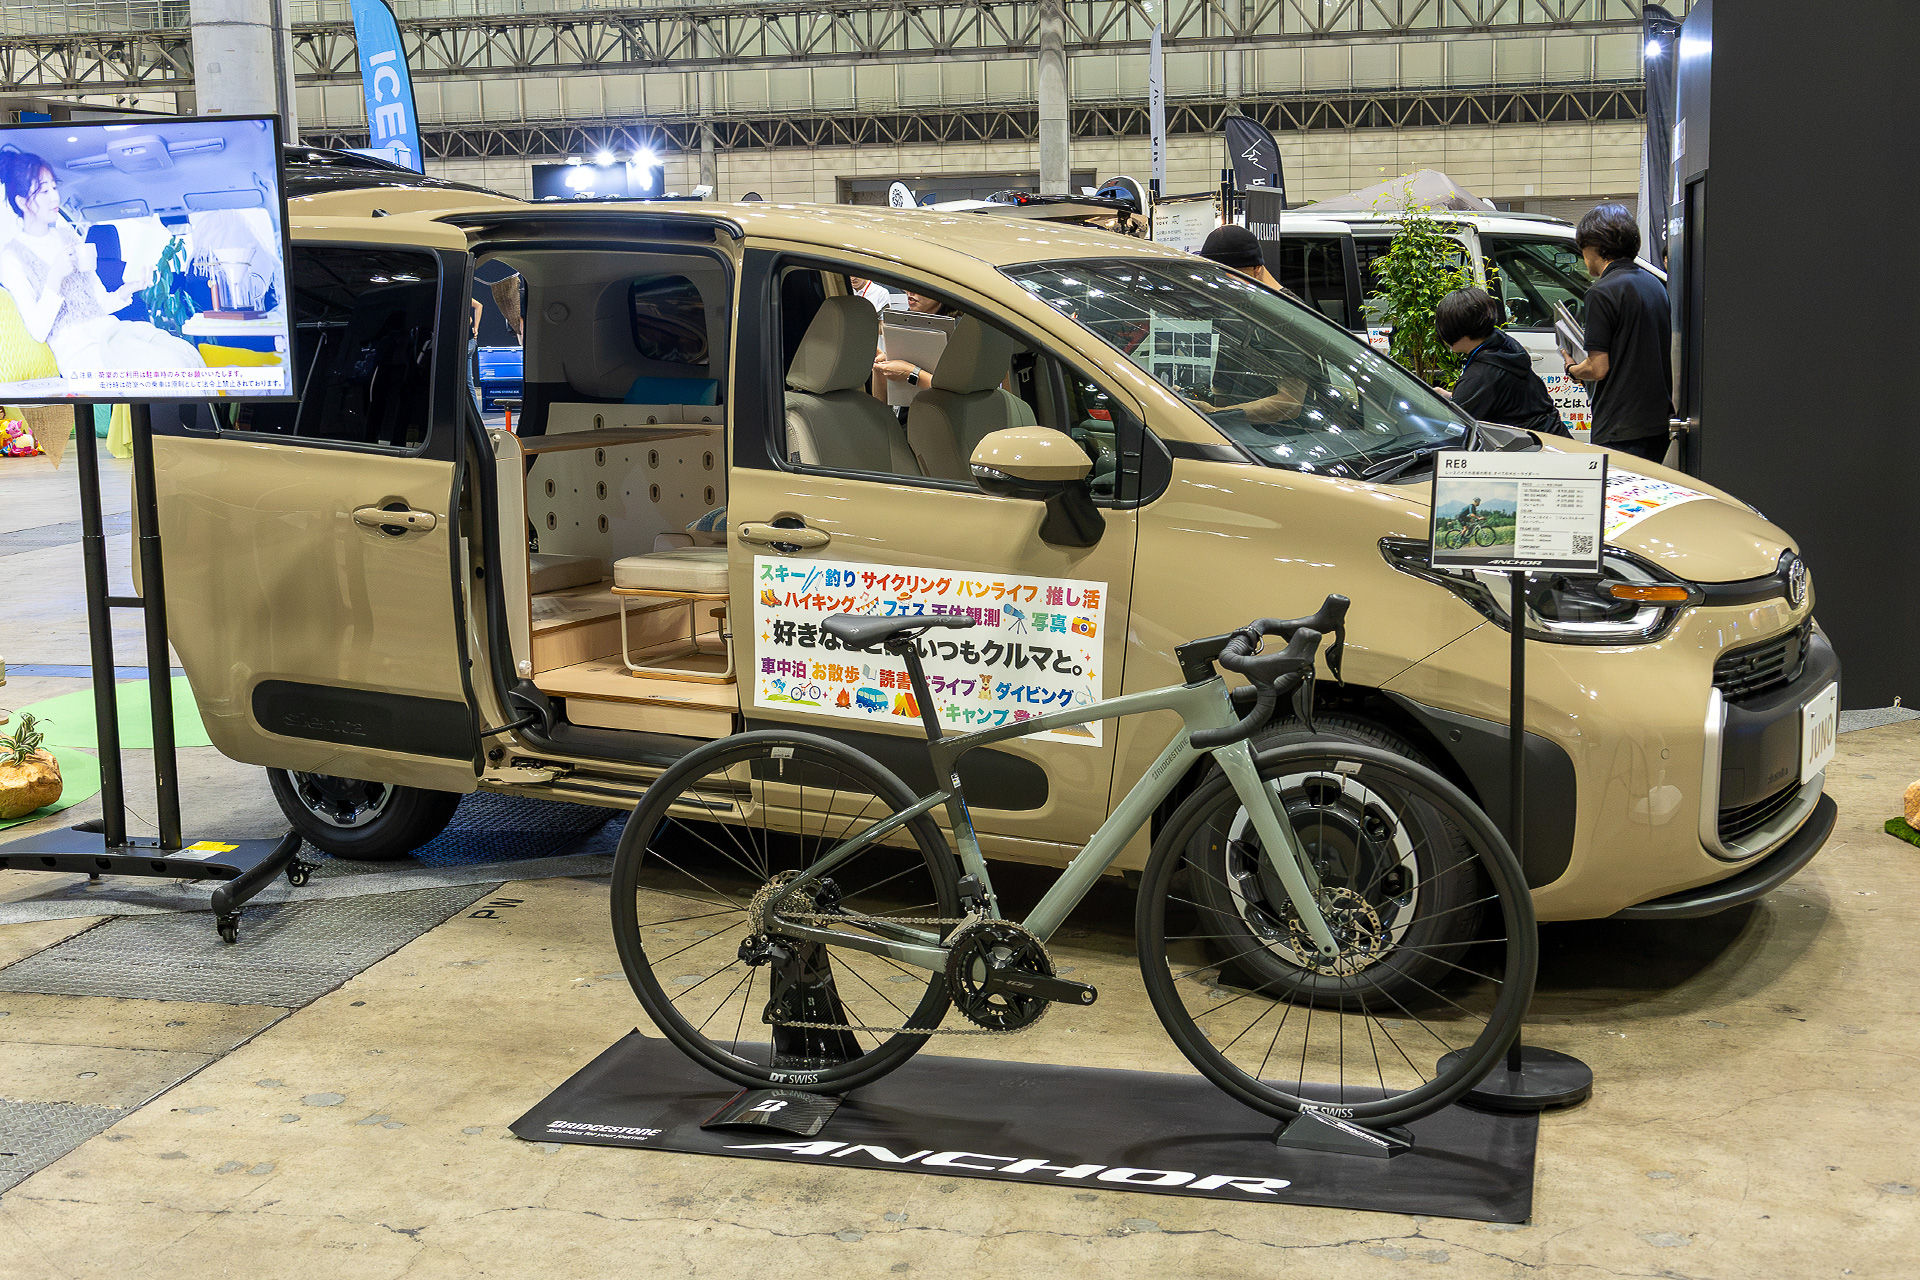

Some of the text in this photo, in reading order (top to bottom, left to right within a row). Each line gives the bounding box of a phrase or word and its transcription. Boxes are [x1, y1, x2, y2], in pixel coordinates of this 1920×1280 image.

[368, 49, 408, 149] ICE
[1445, 459, 1467, 468] RE8
[760, 564, 1101, 610] スキー 釣り サイクリング バンライフ 推し活
[784, 592, 857, 613] ハイキング
[883, 600, 925, 616] フェス
[1031, 612, 1067, 634] 写真
[760, 657, 807, 680] 車中泊
[811, 661, 860, 684] お散歩
[879, 668, 912, 690] 読書
[994, 682, 1075, 708] ダイビング
[945, 703, 1010, 727] キャンプ
[1151, 736, 1190, 781] BRIDGESTONE
[1809, 713, 1833, 765] JUNO
[769, 1072, 819, 1085] DT SWISS
[546, 1120, 663, 1137] BRIDGESTONE
[1320, 1106, 1354, 1118] SWISS
[722, 1140, 1292, 1195] ANCHOR
